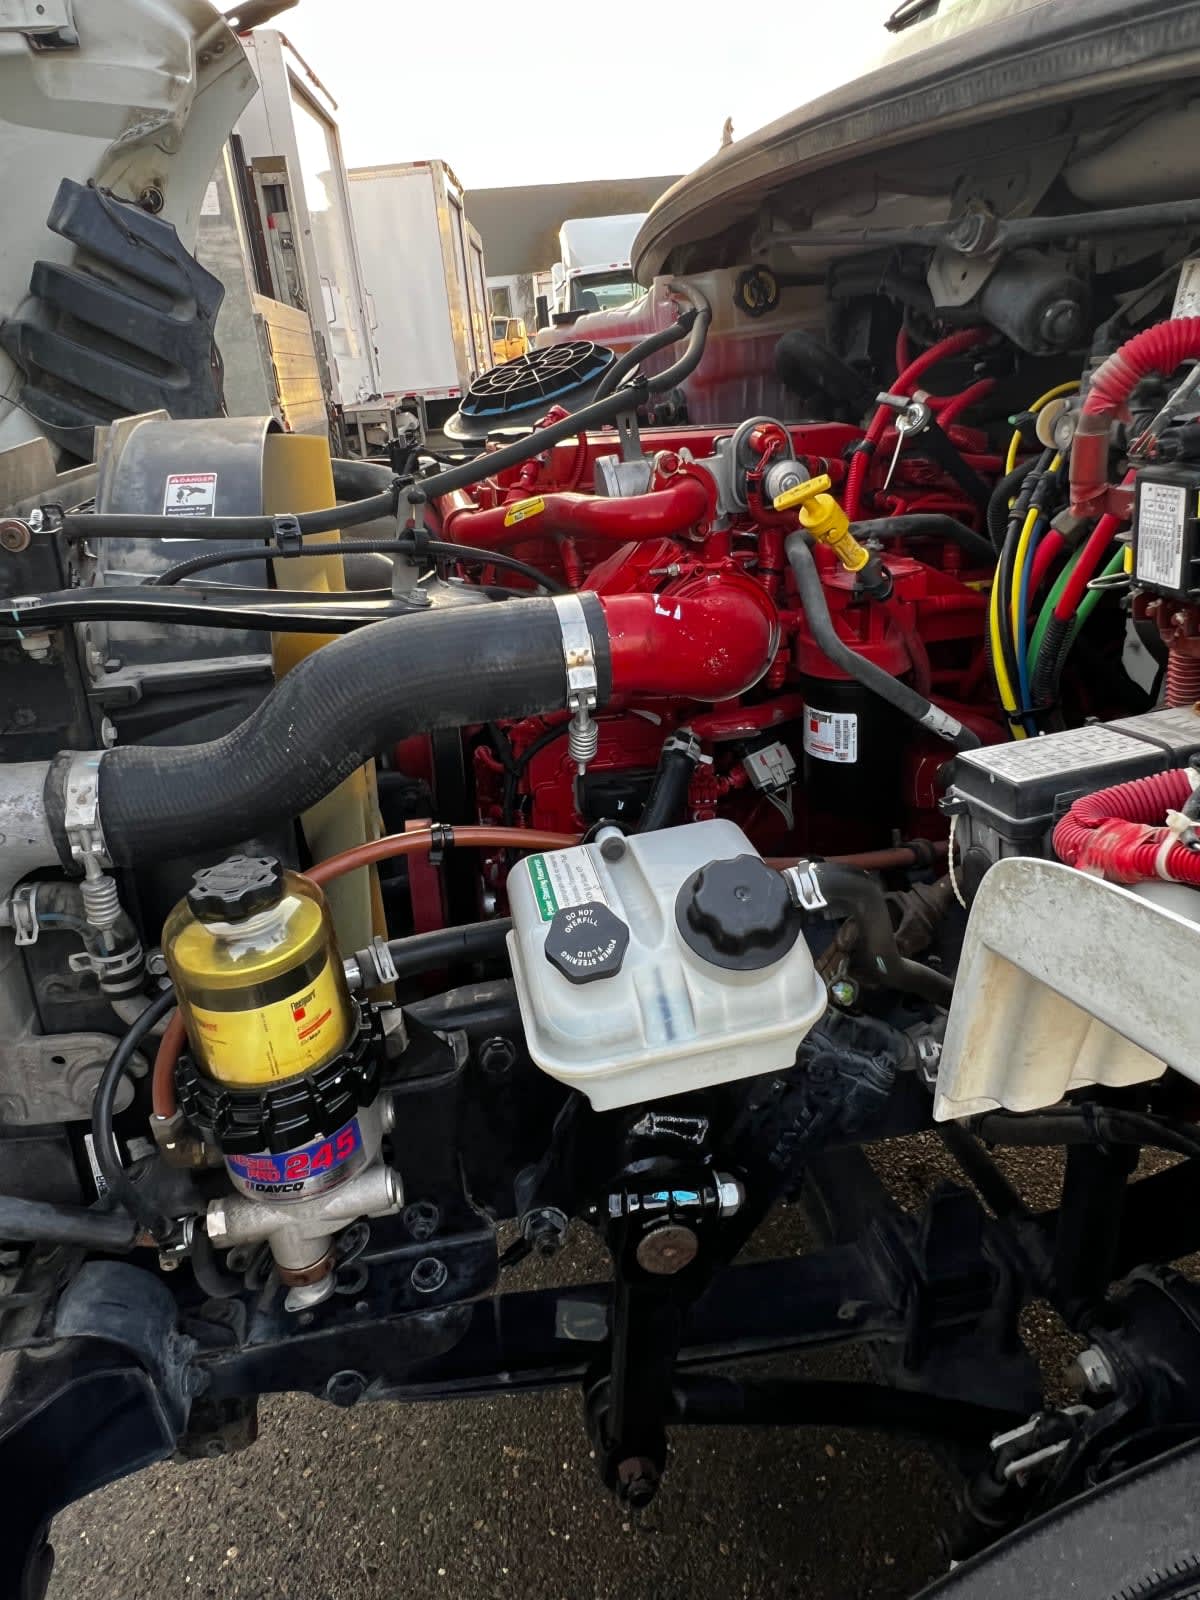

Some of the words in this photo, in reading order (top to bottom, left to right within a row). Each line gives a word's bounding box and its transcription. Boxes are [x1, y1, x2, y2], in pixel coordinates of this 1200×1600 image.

[540, 880, 551, 900] Steering
[565, 912, 576, 921] DO
[579, 909, 594, 917] NOT
[564, 916, 598, 934] OVERFILL
[560, 951, 598, 967] STEERING
[577, 946, 604, 958] FLUID
[599, 939, 617, 962] POWER
[285, 1126, 356, 1181] 245
[255, 1181, 305, 1194] DAVCO
